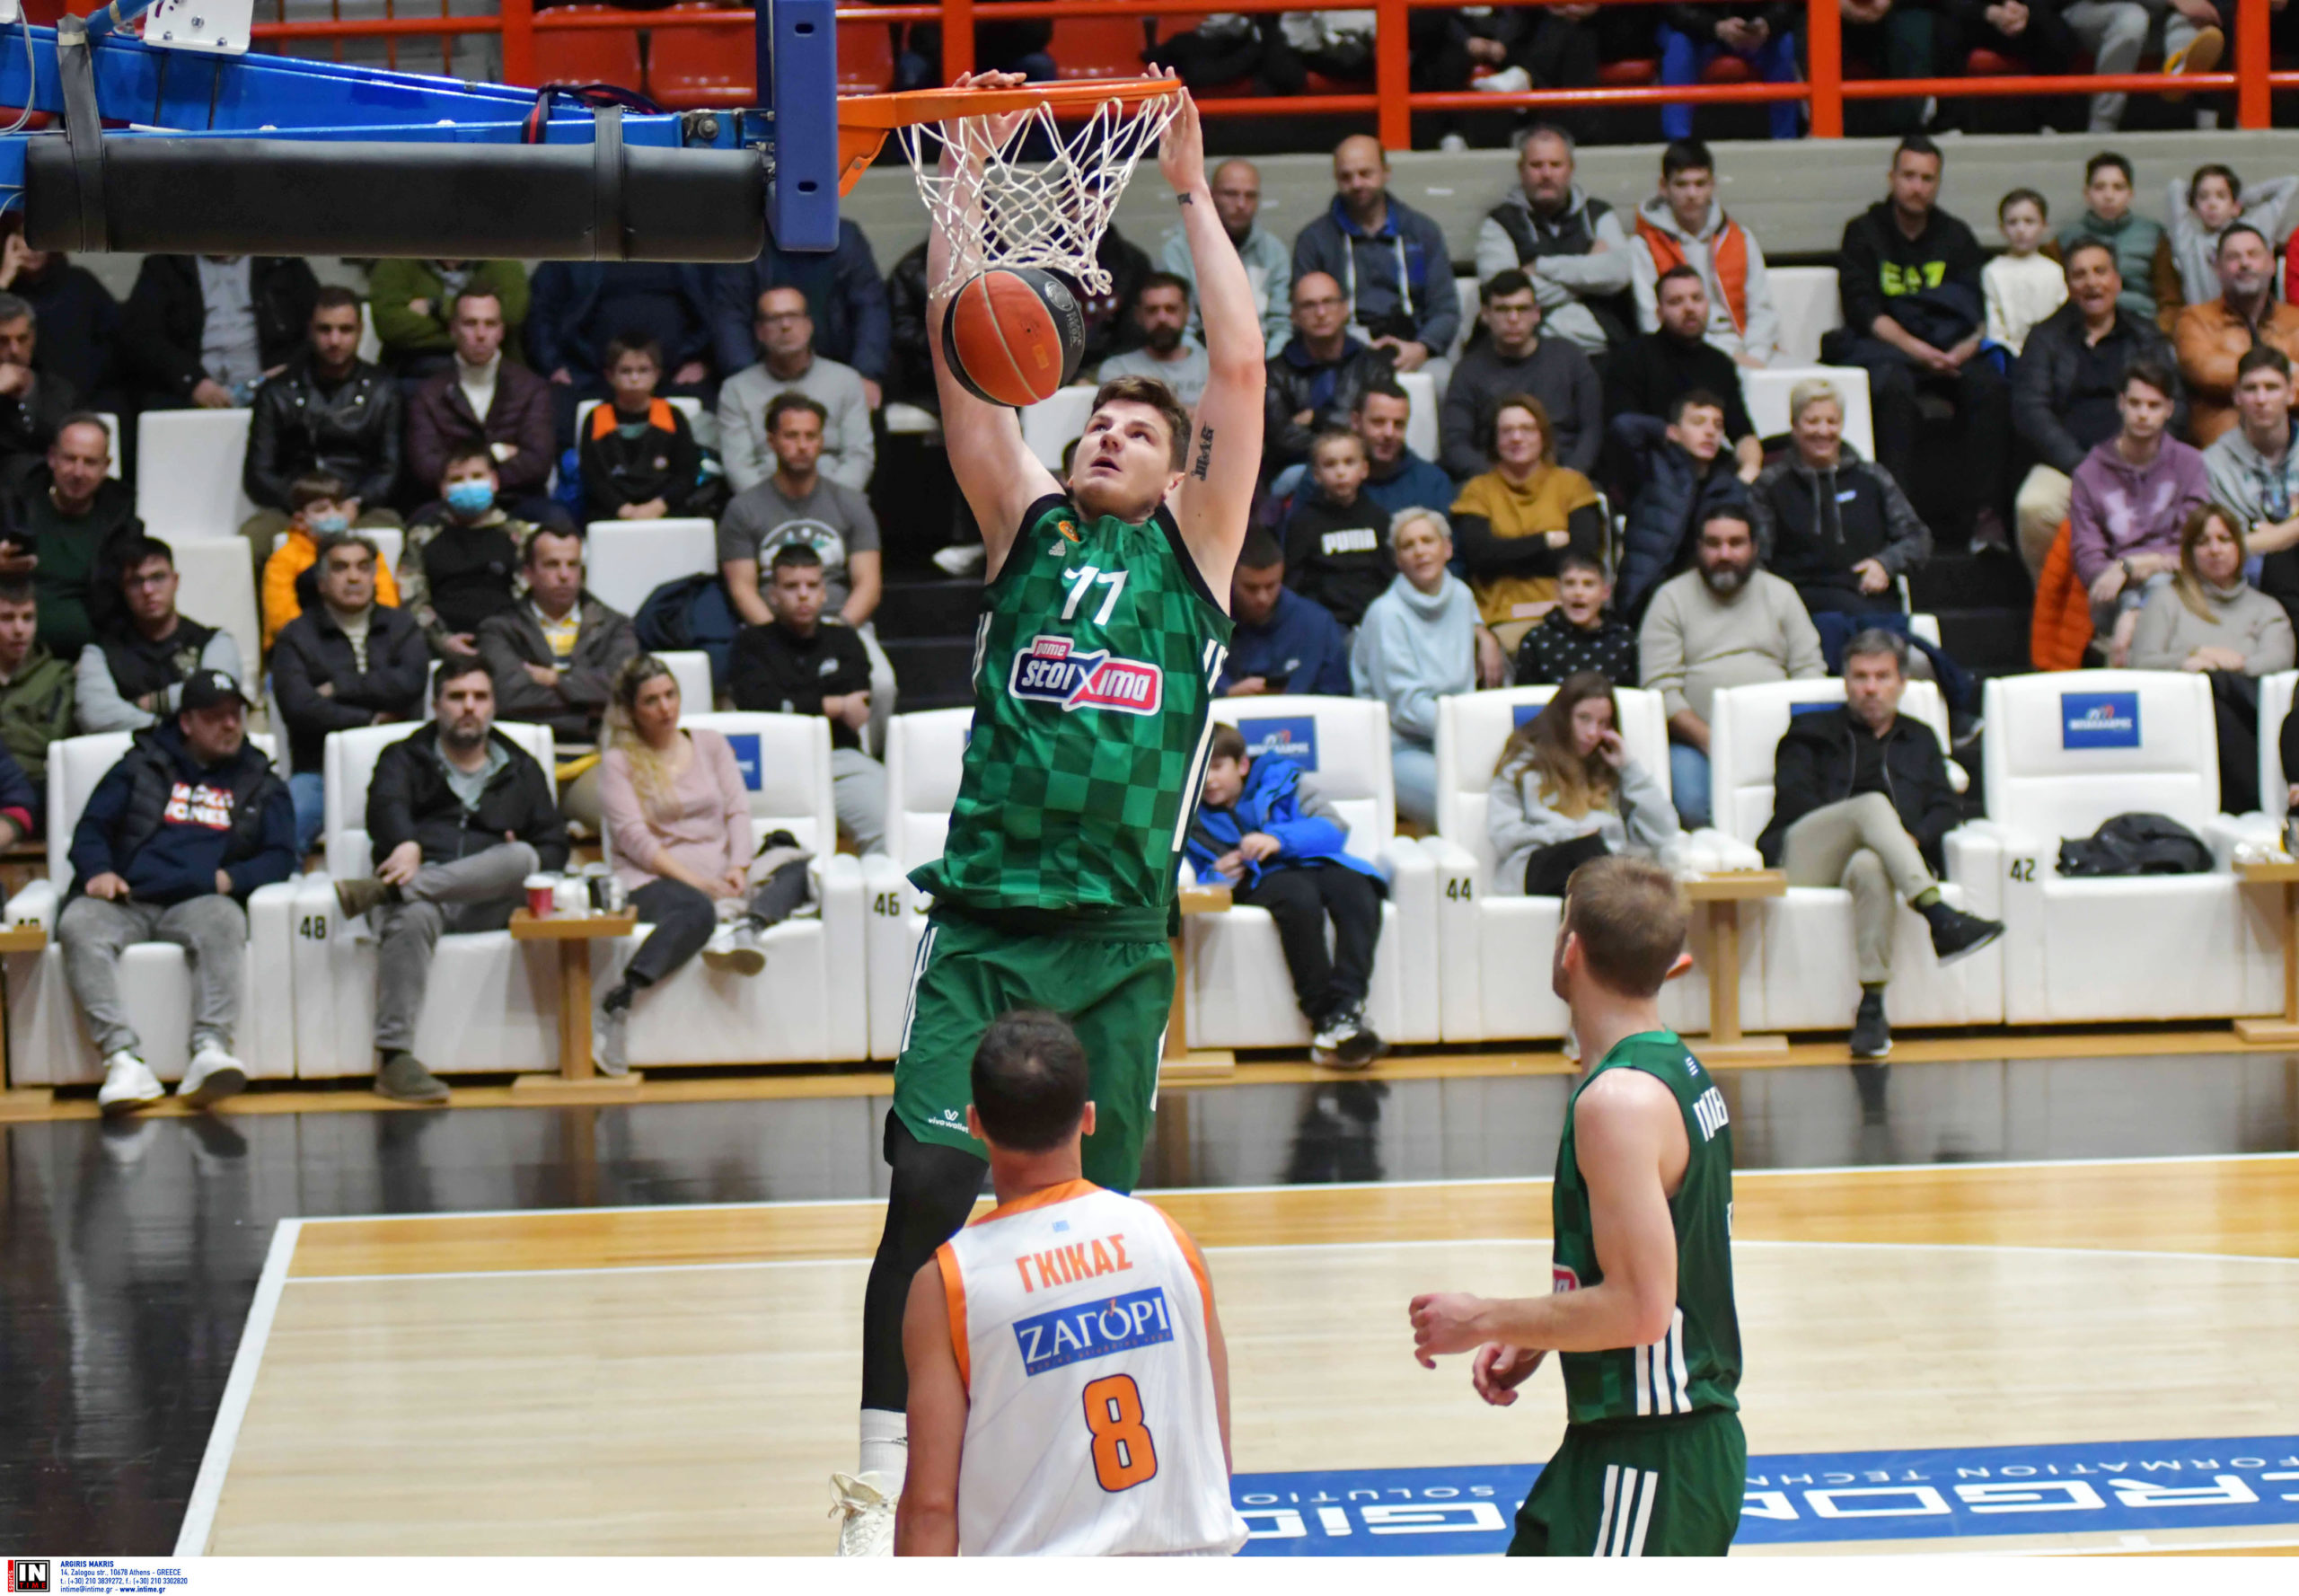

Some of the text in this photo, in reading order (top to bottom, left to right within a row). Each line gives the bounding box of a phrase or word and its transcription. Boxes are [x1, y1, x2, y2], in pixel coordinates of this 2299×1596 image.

[1881, 260, 1946, 296] EA7
[2010, 858, 2036, 882] 42
[1447, 877, 1471, 902] 44
[874, 893, 900, 916] 46
[299, 915, 327, 940] 48
[1016, 1234, 1133, 1293] ΓΚΙΚΑΣ
[1082, 1373, 1158, 1493] 8
[1745, 1468, 1930, 1486] TECHN
[1242, 1485, 1495, 1505] SOLUTIO
